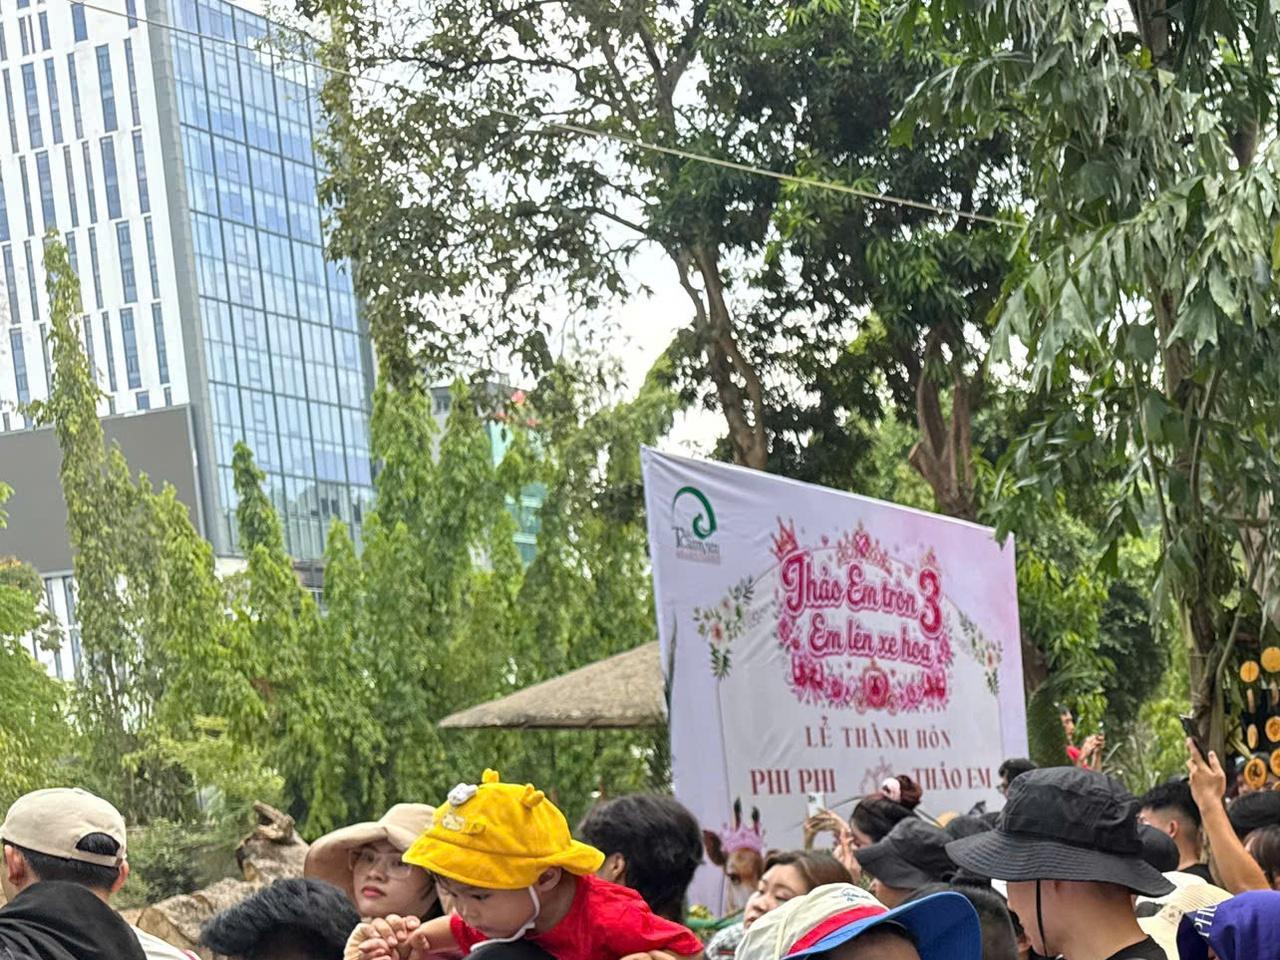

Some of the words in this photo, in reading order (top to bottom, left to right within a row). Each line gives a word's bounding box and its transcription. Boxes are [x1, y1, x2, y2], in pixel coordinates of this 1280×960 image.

[782, 552, 843, 616] Thảo
[847, 564, 880, 612] Em
[918, 568, 943, 637] 3
[810, 613, 843, 657] Em
[847, 619, 873, 657] lên
[878, 633, 899, 661] xe
[901, 624, 933, 668] hoa
[842, 723, 909, 749] THÀNH
[750, 767, 792, 795] PHI
[798, 768, 836, 794] PHI
[968, 767, 993, 790] EM
